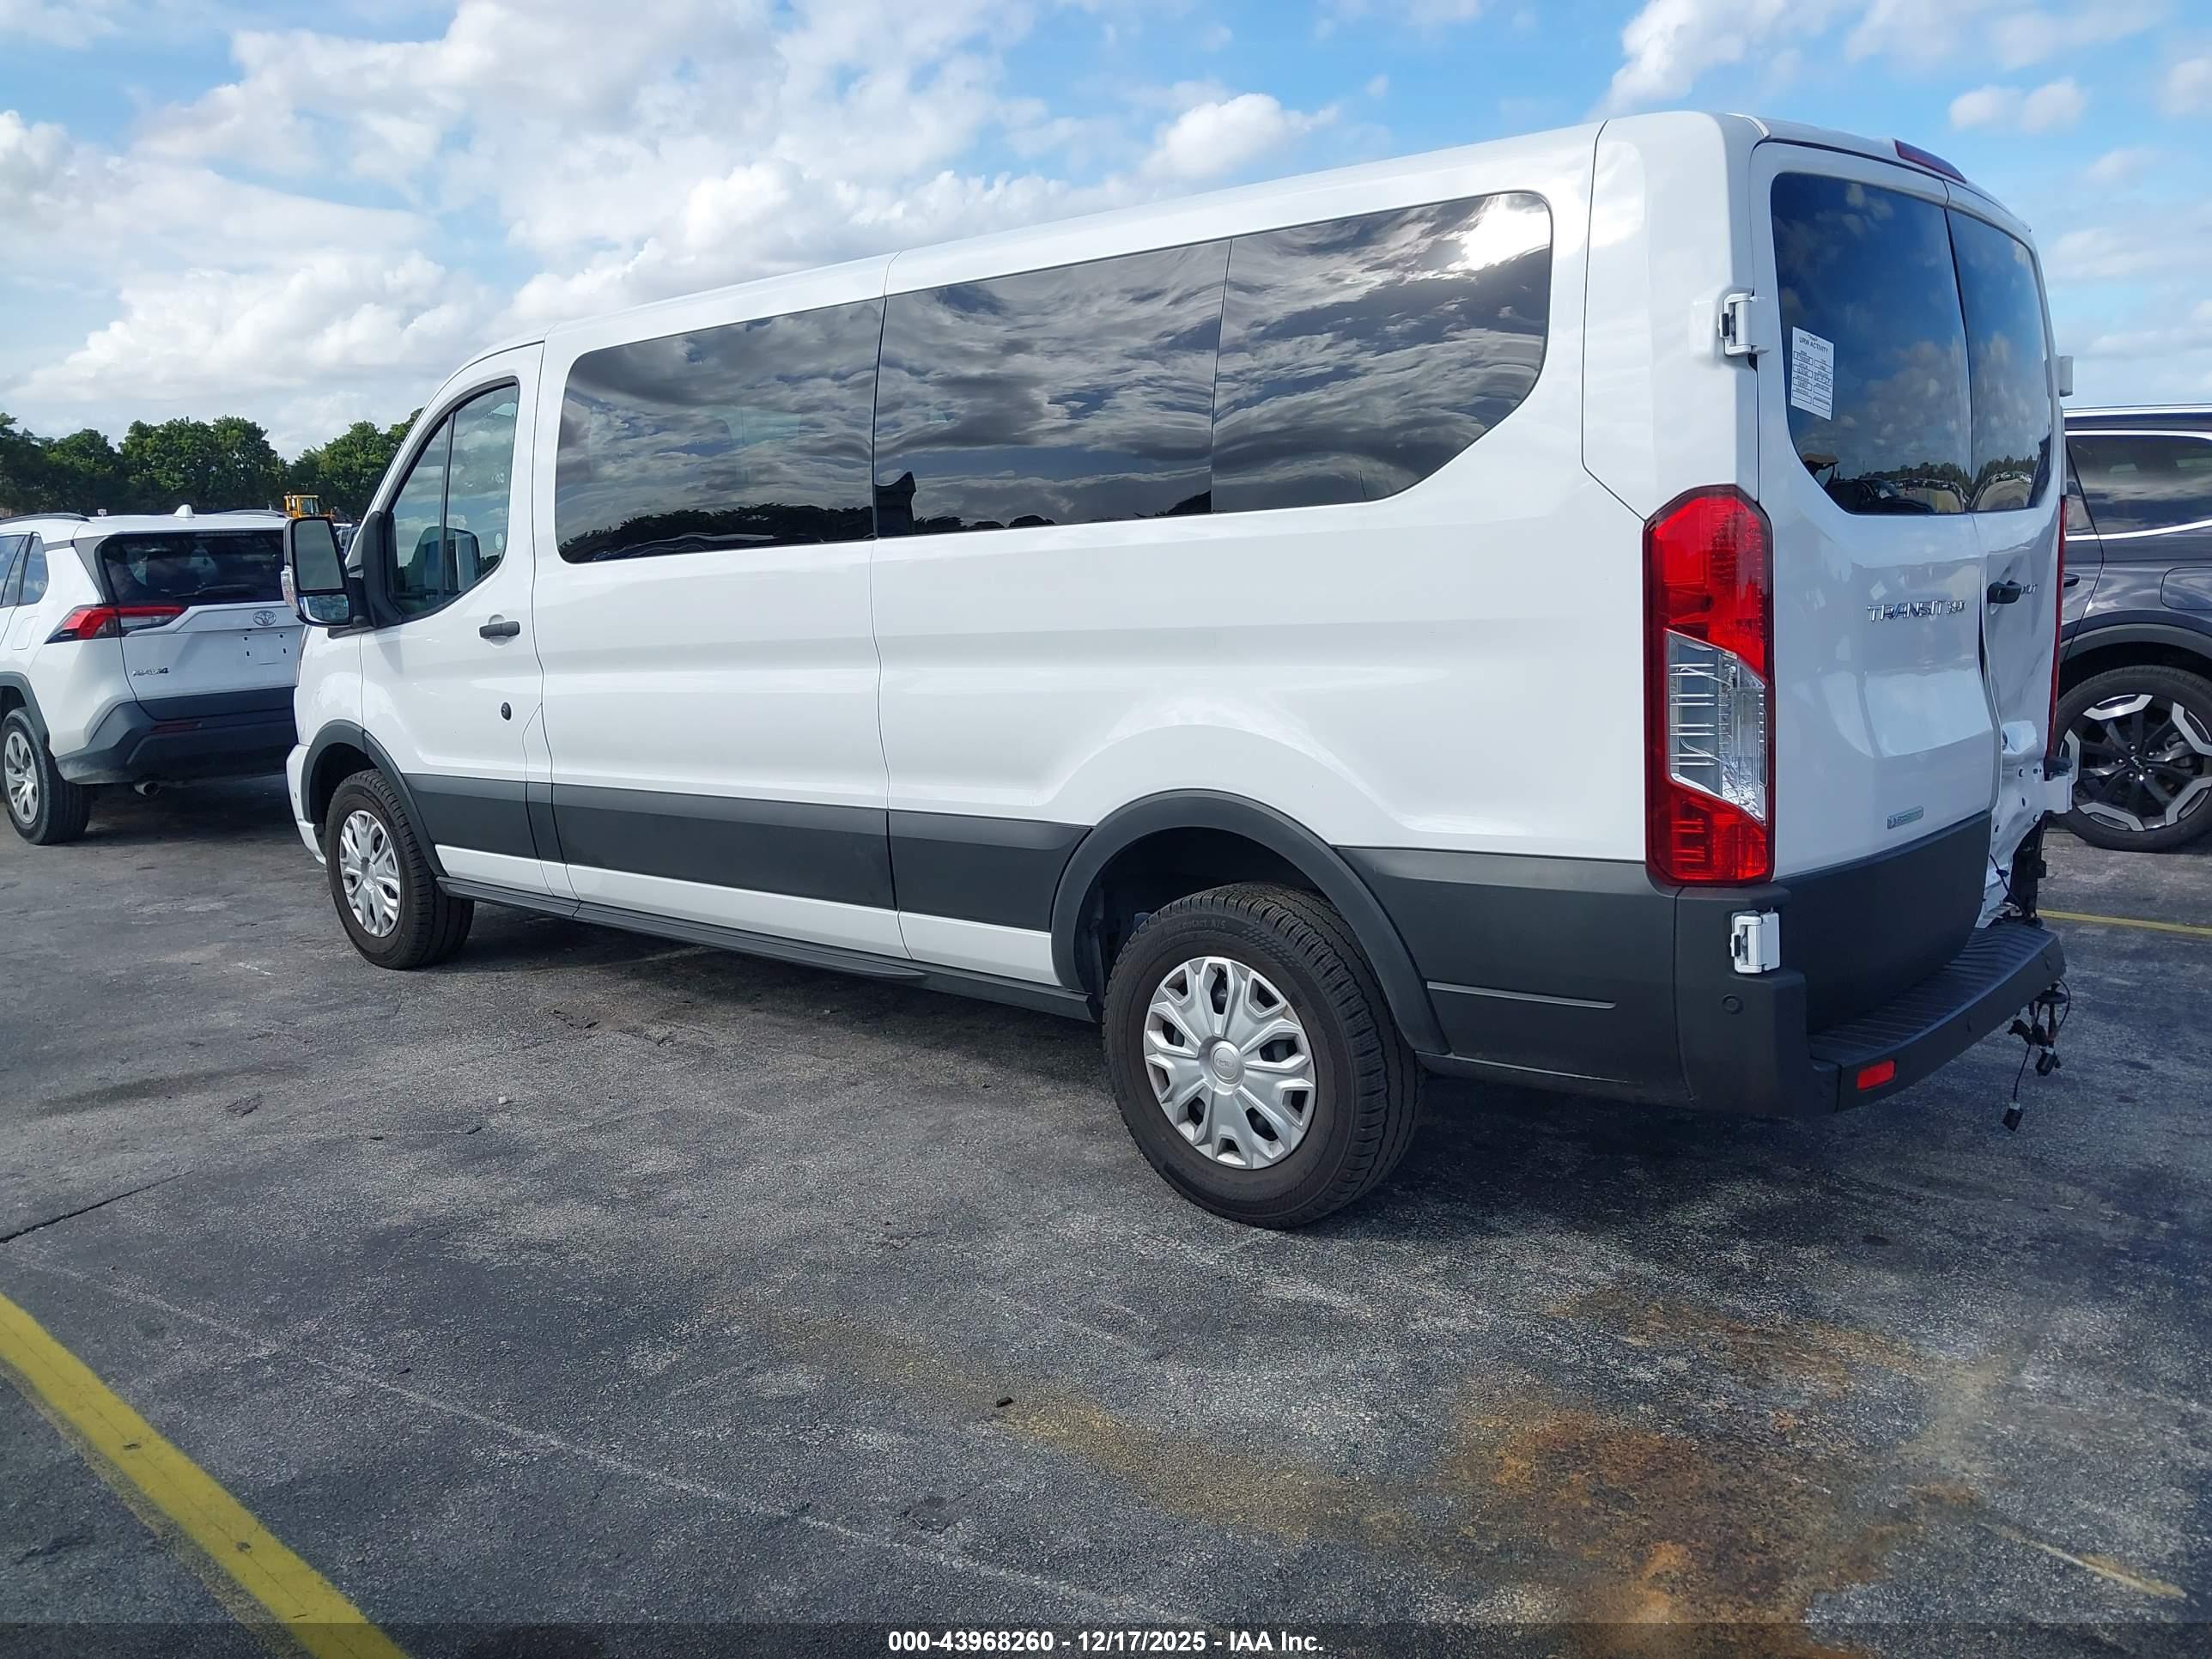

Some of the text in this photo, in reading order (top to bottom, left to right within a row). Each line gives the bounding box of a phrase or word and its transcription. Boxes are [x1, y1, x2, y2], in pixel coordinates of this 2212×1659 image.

[1810, 341, 1829, 355] ACTIVITY
[1867, 599, 1945, 622] TRANSIT
[131, 667, 169, 678] RAV4
